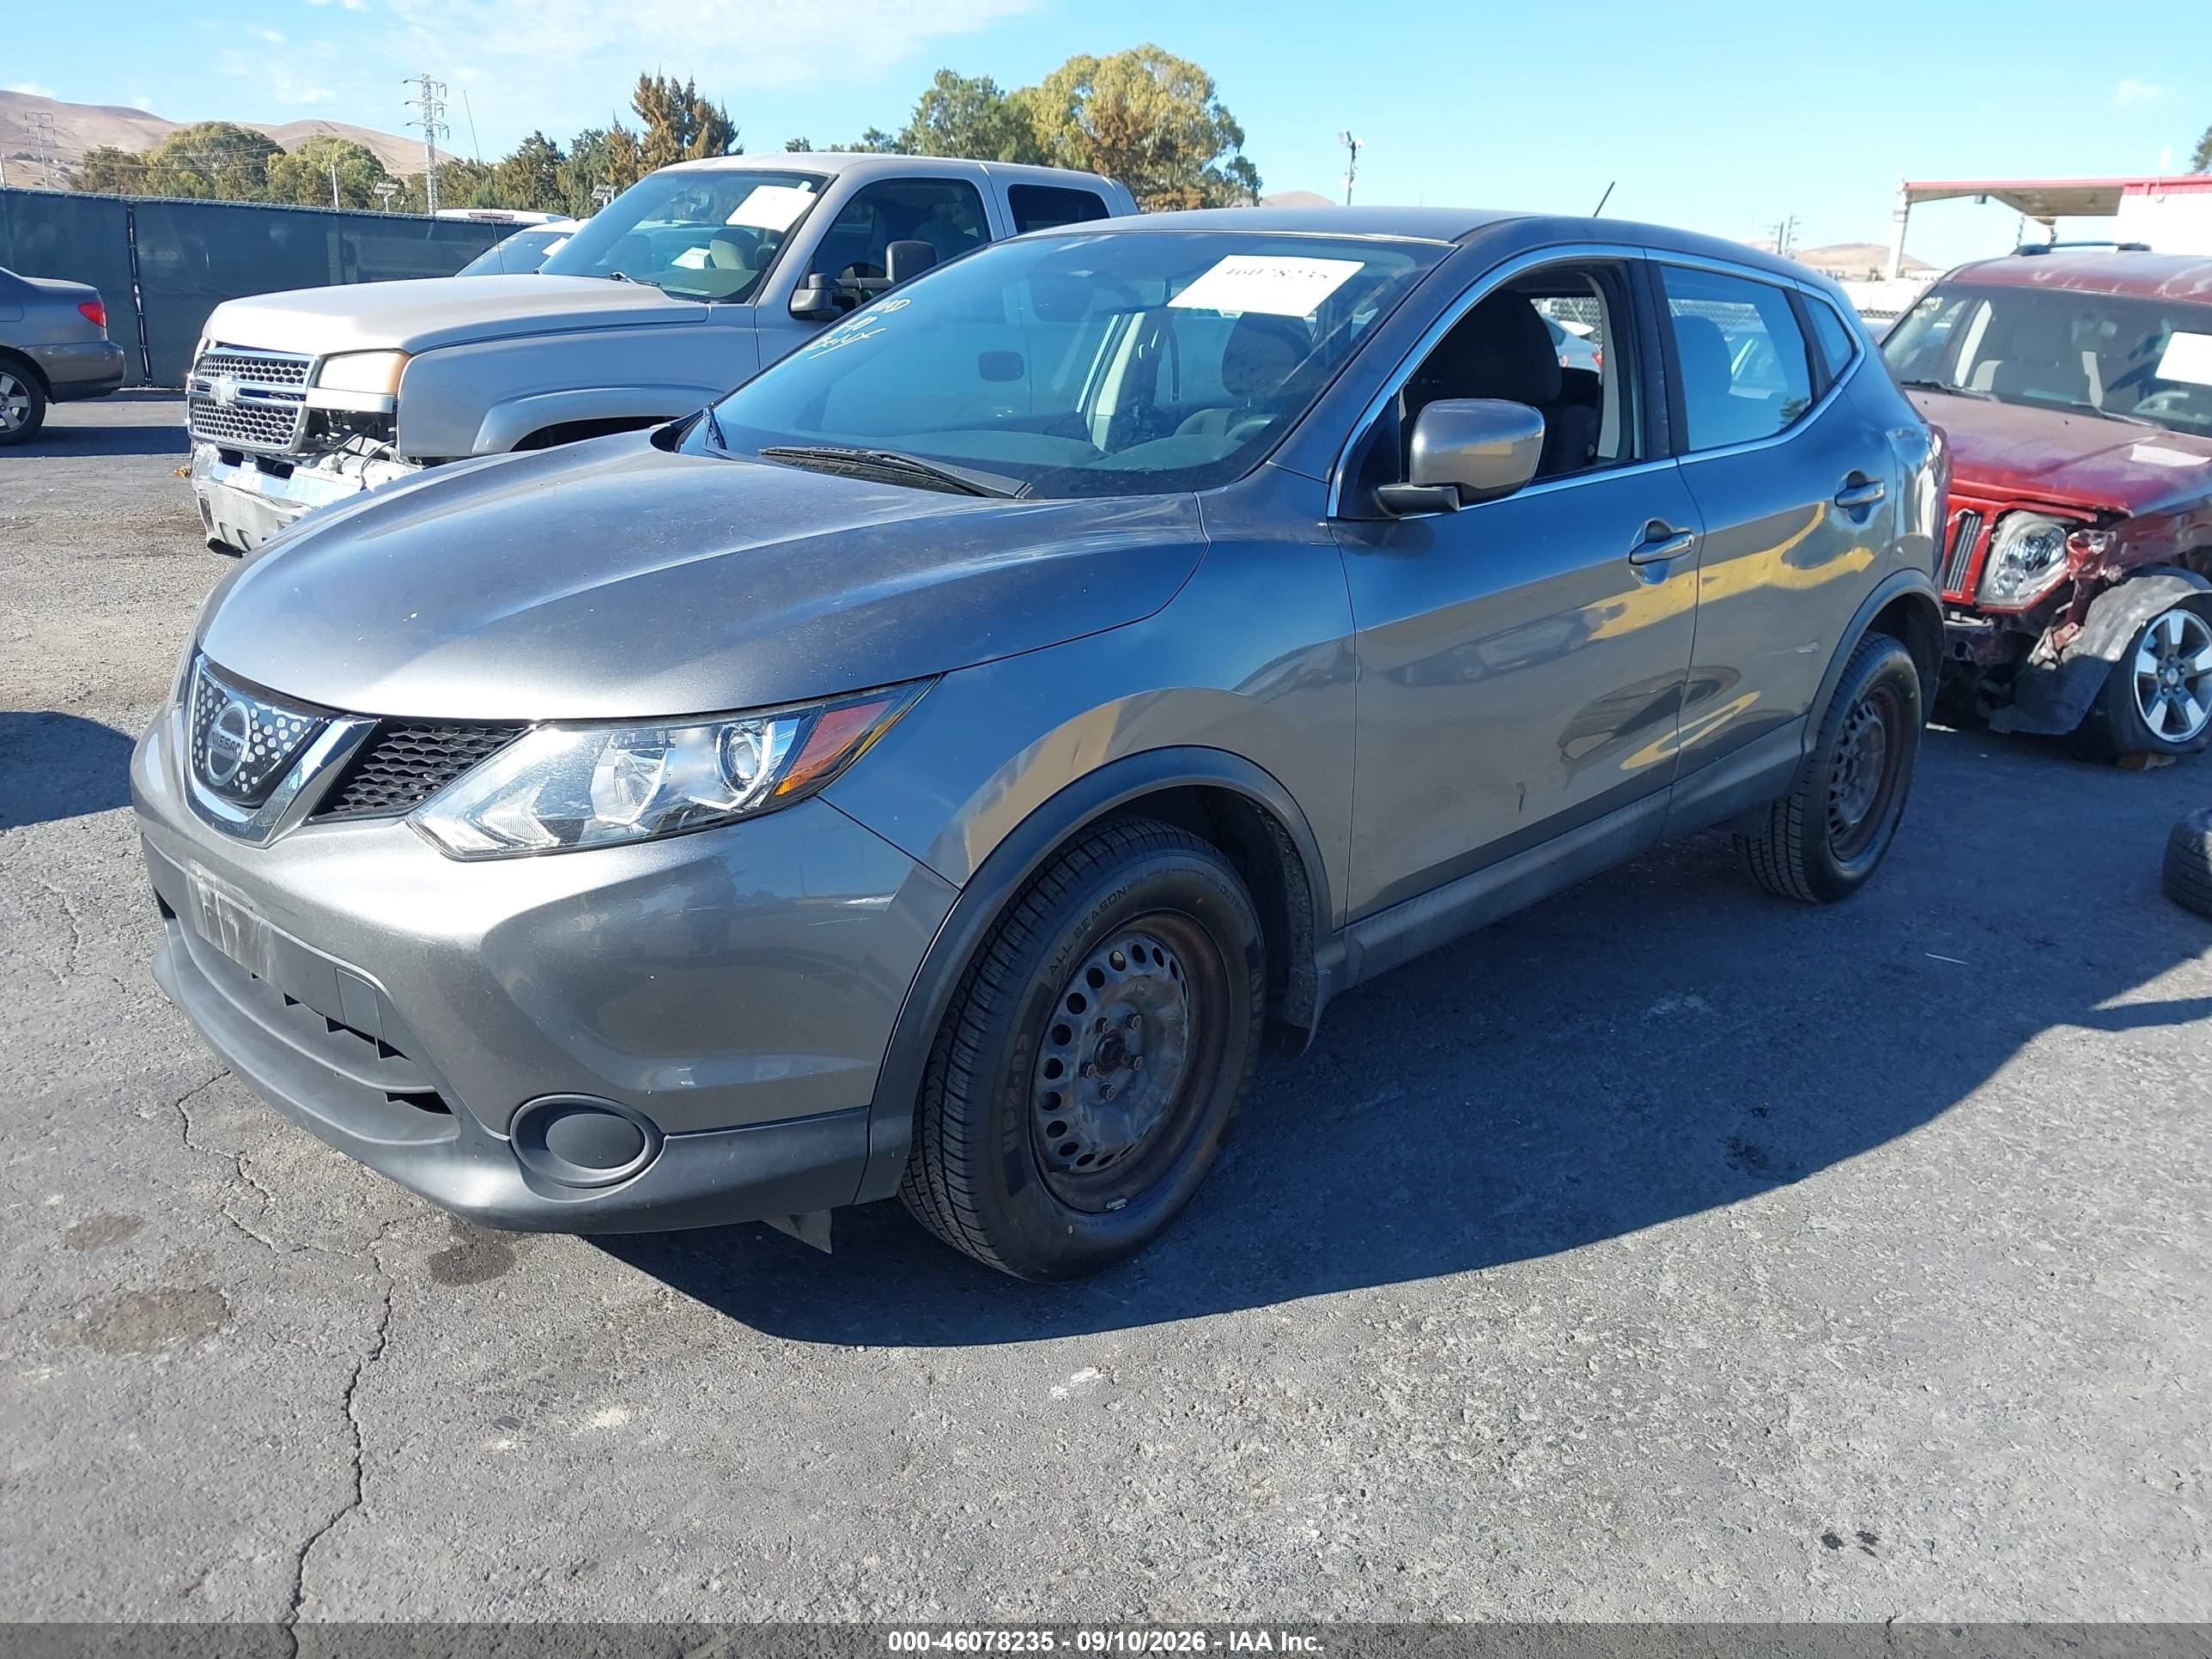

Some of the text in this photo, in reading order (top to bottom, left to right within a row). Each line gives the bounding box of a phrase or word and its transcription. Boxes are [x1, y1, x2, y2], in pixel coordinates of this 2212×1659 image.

[210, 731, 245, 757] NISSAN
[1049, 885, 1127, 976] ALL SEASON
